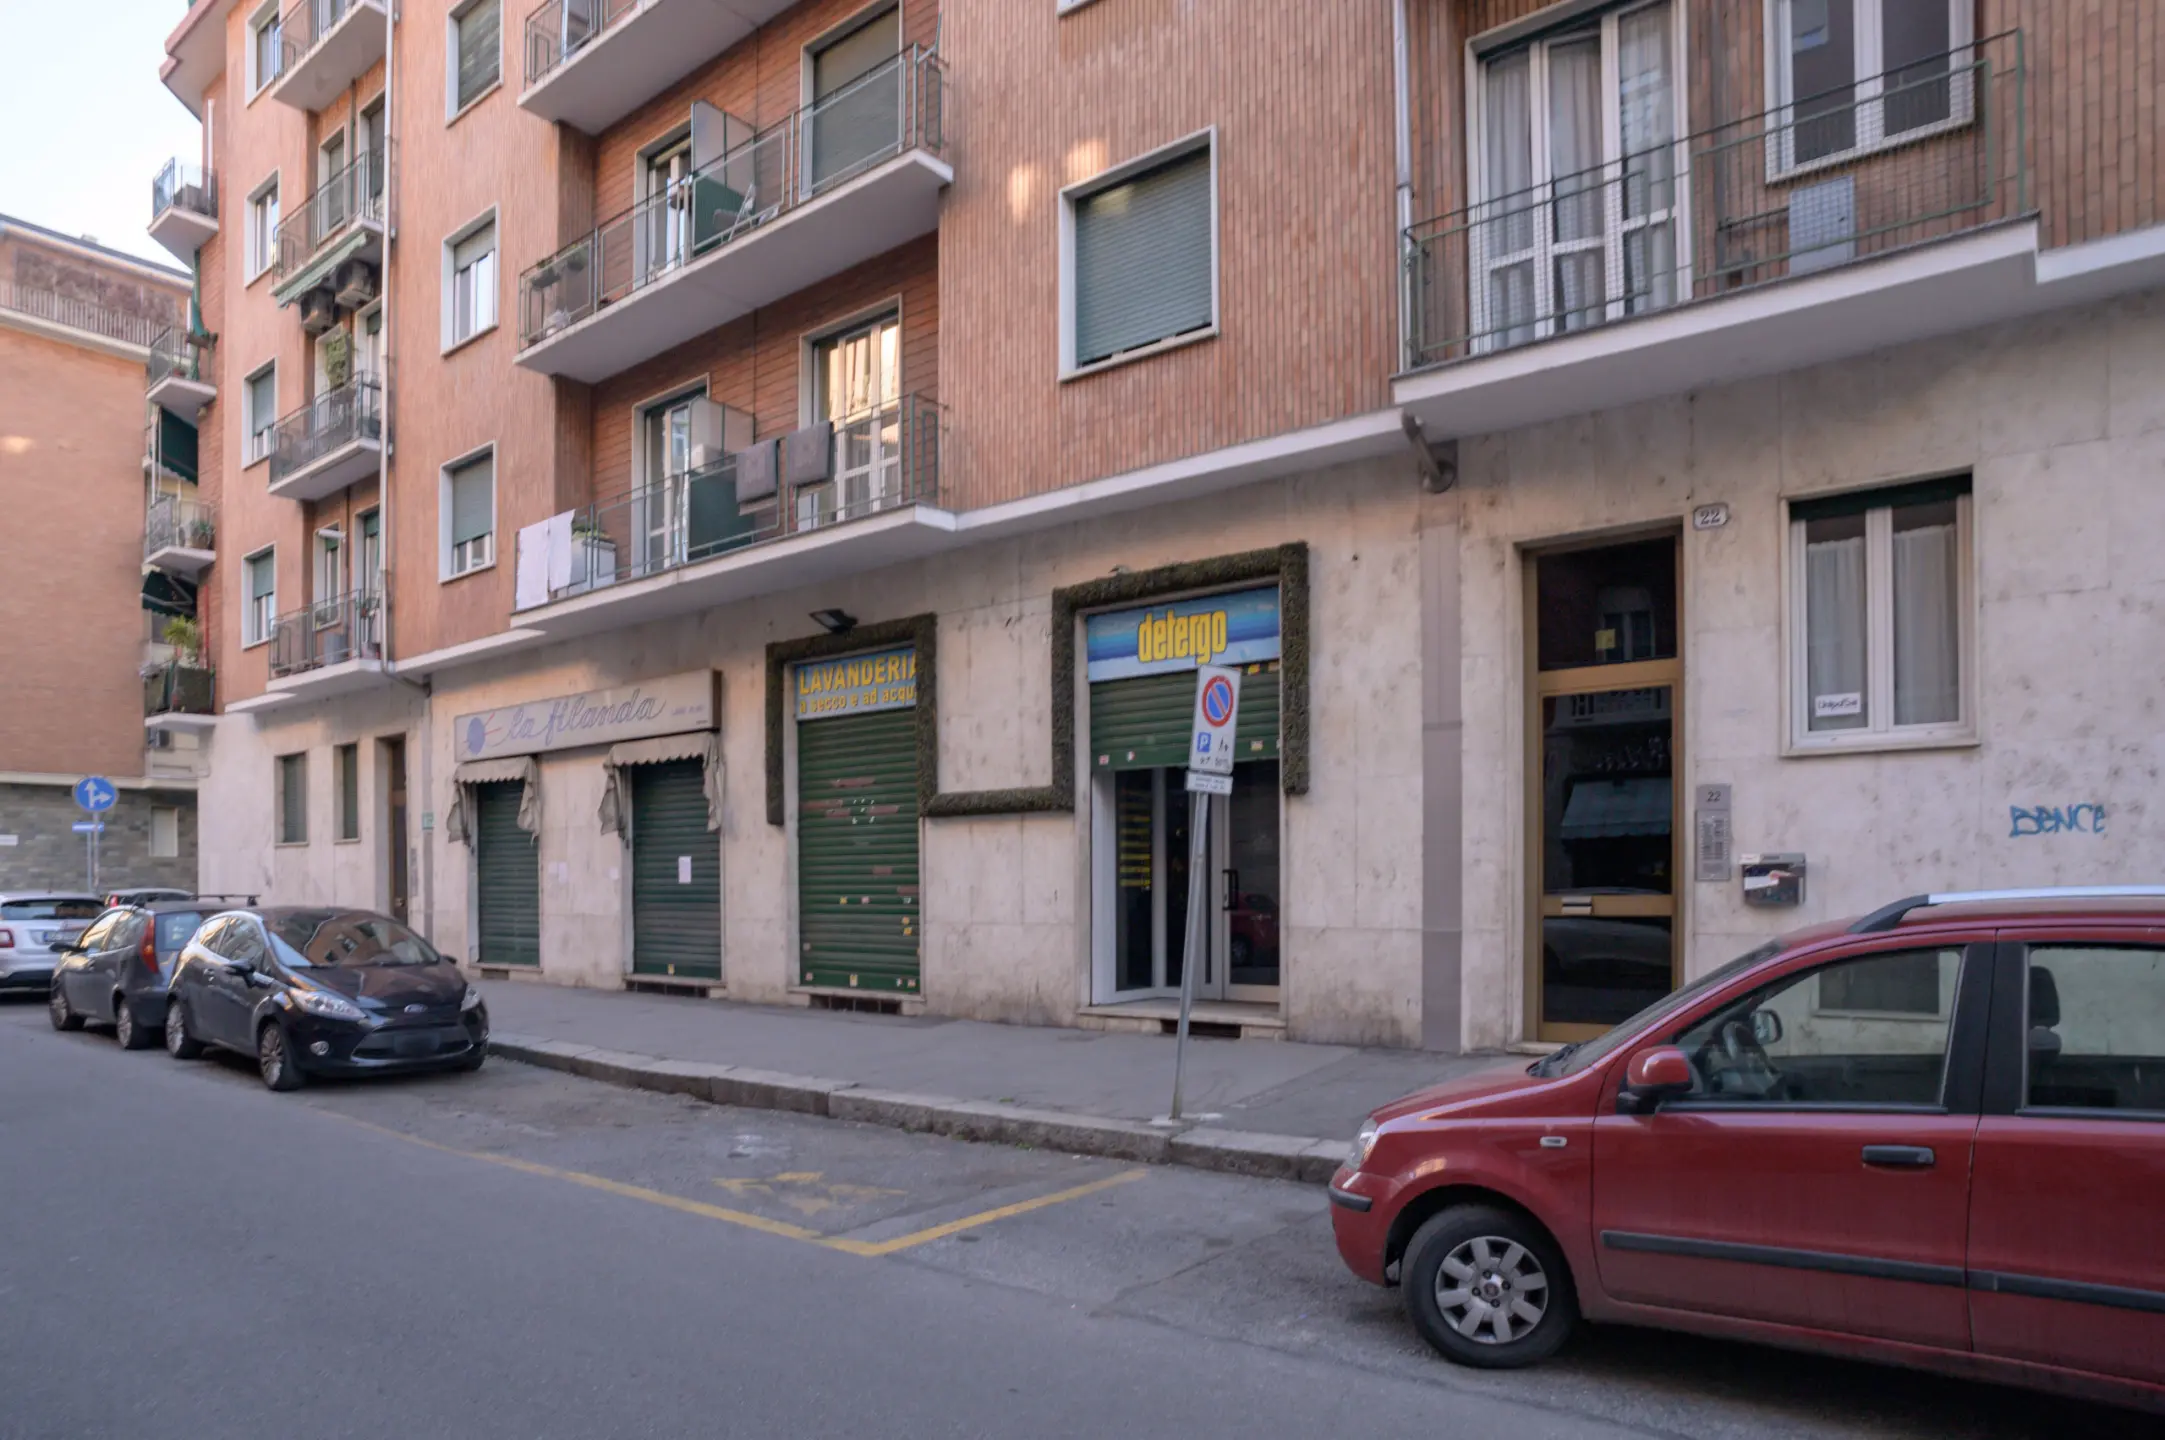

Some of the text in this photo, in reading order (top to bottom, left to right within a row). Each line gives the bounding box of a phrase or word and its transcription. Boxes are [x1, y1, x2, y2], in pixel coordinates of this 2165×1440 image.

[1700, 508, 1720, 525] 22
[1138, 608, 1227, 665] detergo
[811, 694, 847, 713] secco
[850, 692, 859, 707] e
[863, 687, 878, 706] ad
[883, 683, 917, 705] acqu
[545, 687, 666, 746] filanda
[1706, 790, 1721, 802] 22
